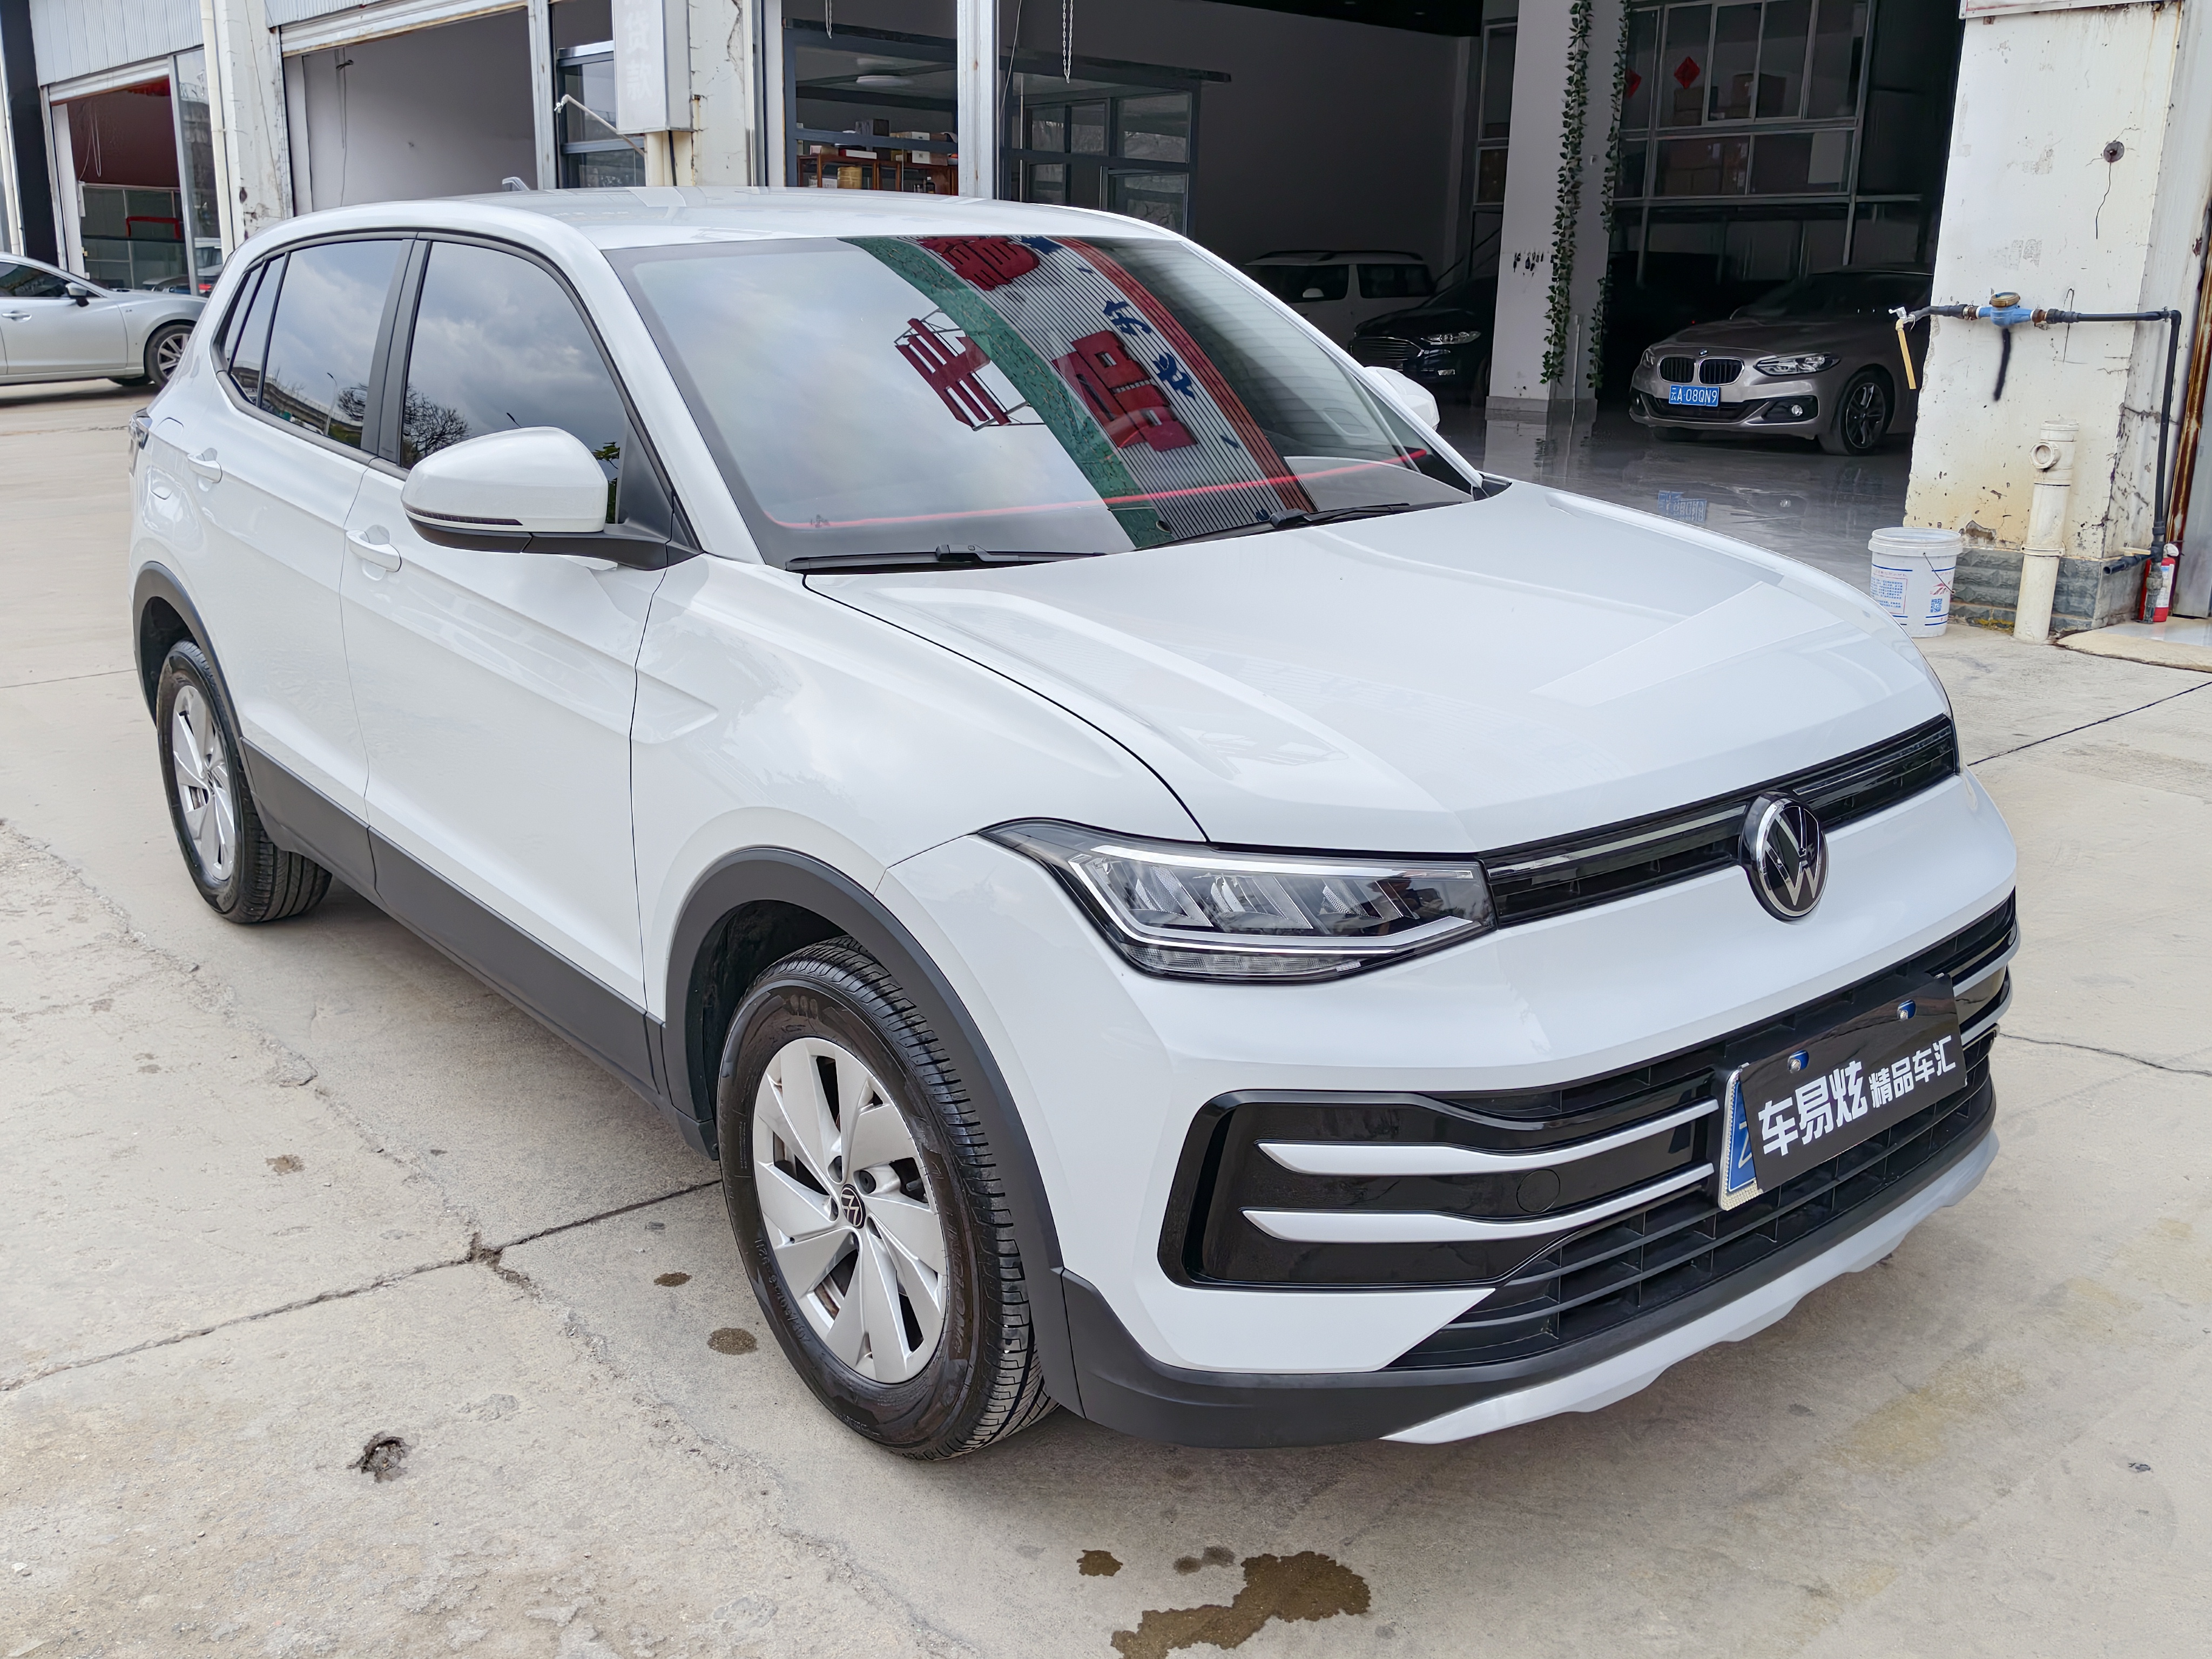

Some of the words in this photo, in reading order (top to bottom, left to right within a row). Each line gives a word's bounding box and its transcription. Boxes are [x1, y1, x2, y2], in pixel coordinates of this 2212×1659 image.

[1758, 1060, 1868, 1156] 车易炫
[1869, 1035, 1957, 1109] 精品车汇
